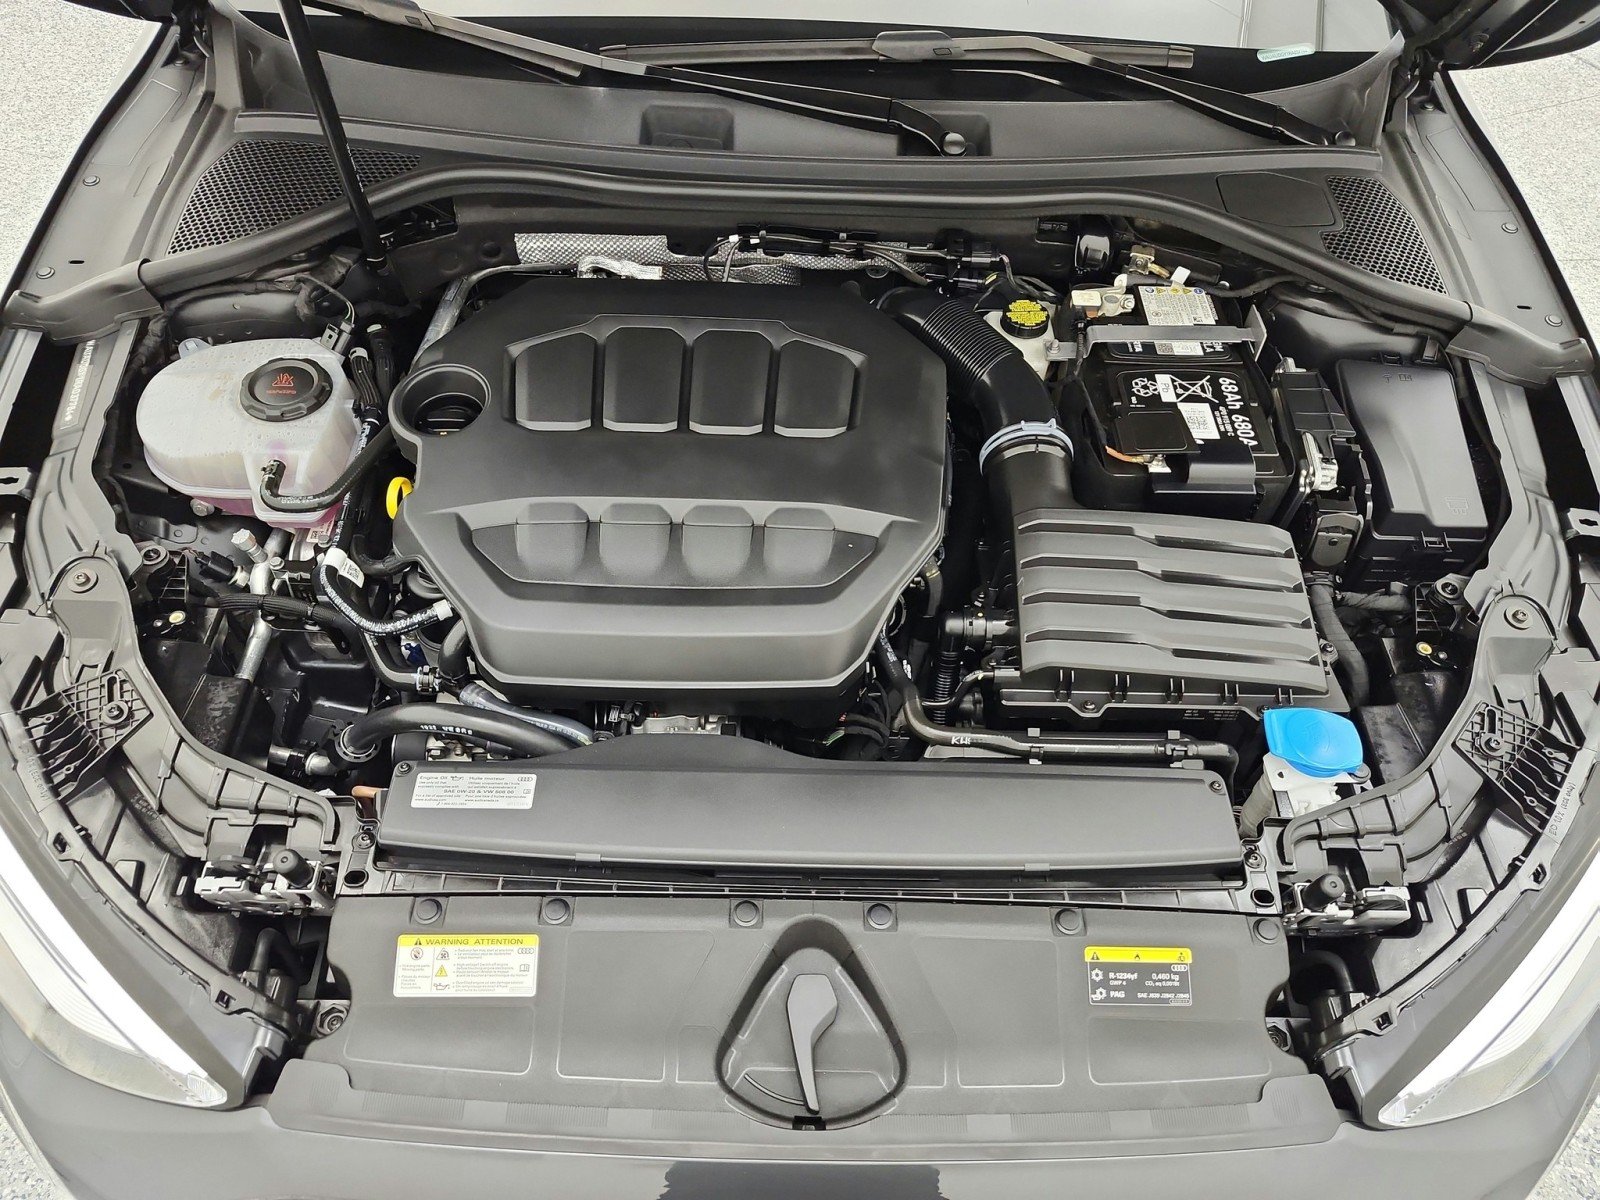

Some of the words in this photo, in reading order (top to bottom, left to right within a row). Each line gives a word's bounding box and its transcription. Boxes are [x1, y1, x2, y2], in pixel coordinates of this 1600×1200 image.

[1219, 377, 1244, 409] 68Ah
[1231, 414, 1259, 446] 680A
[1108, 972, 1138, 980] R-1234yf
[1171, 973, 1180, 982] kg
[1109, 990, 1125, 998] PAG
